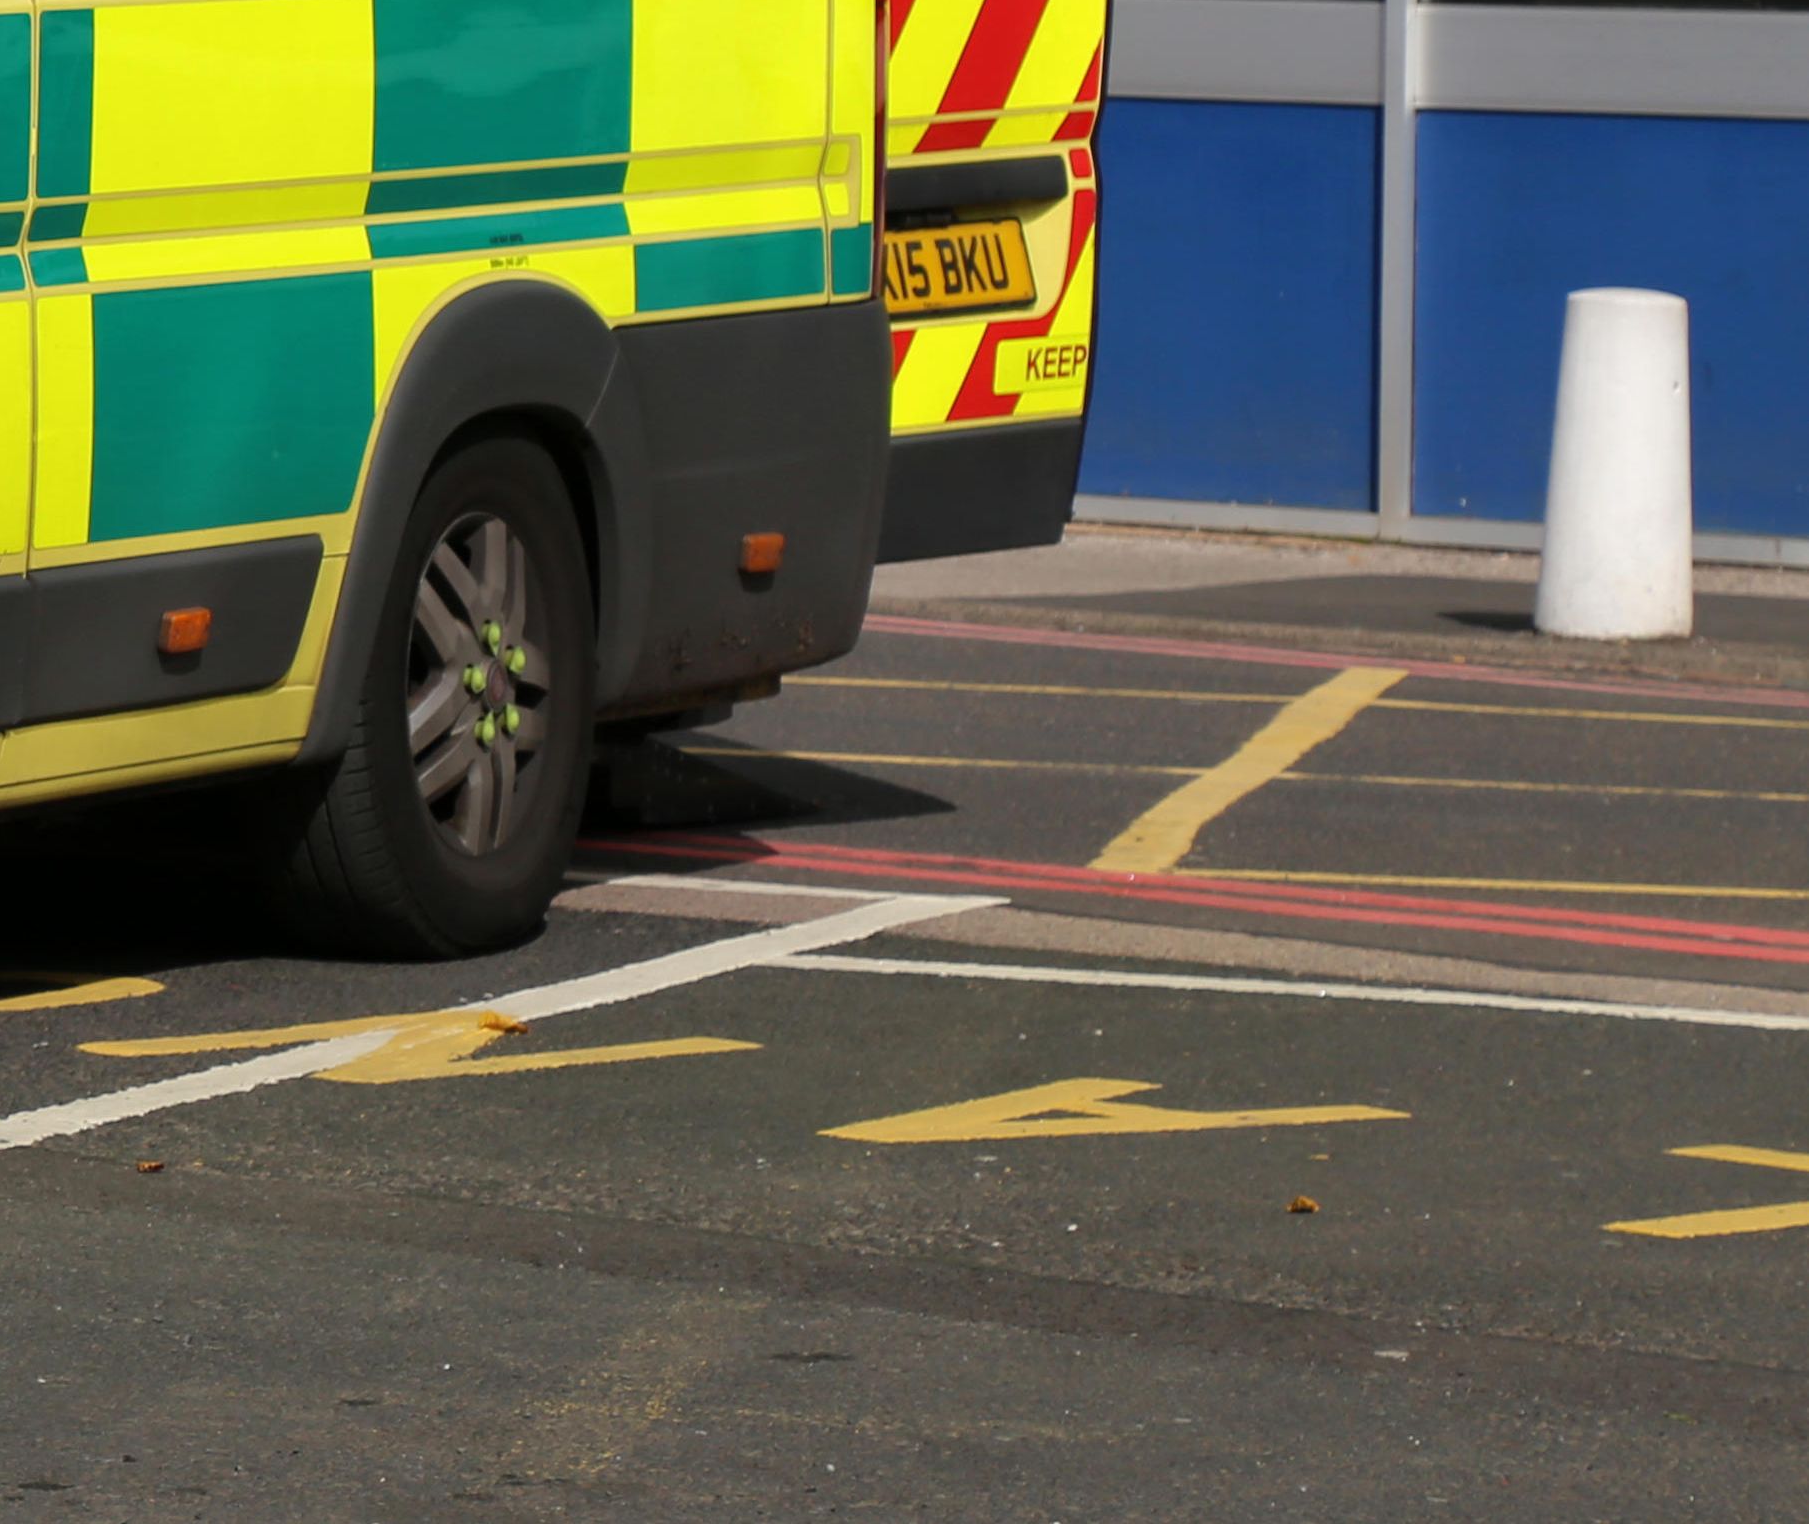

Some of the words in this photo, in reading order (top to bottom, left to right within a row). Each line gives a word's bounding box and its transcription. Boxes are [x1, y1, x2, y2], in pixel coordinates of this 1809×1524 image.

[884, 240, 931, 301] X15
[934, 233, 1009, 295] BKU
[1025, 344, 1088, 382] KEEP
